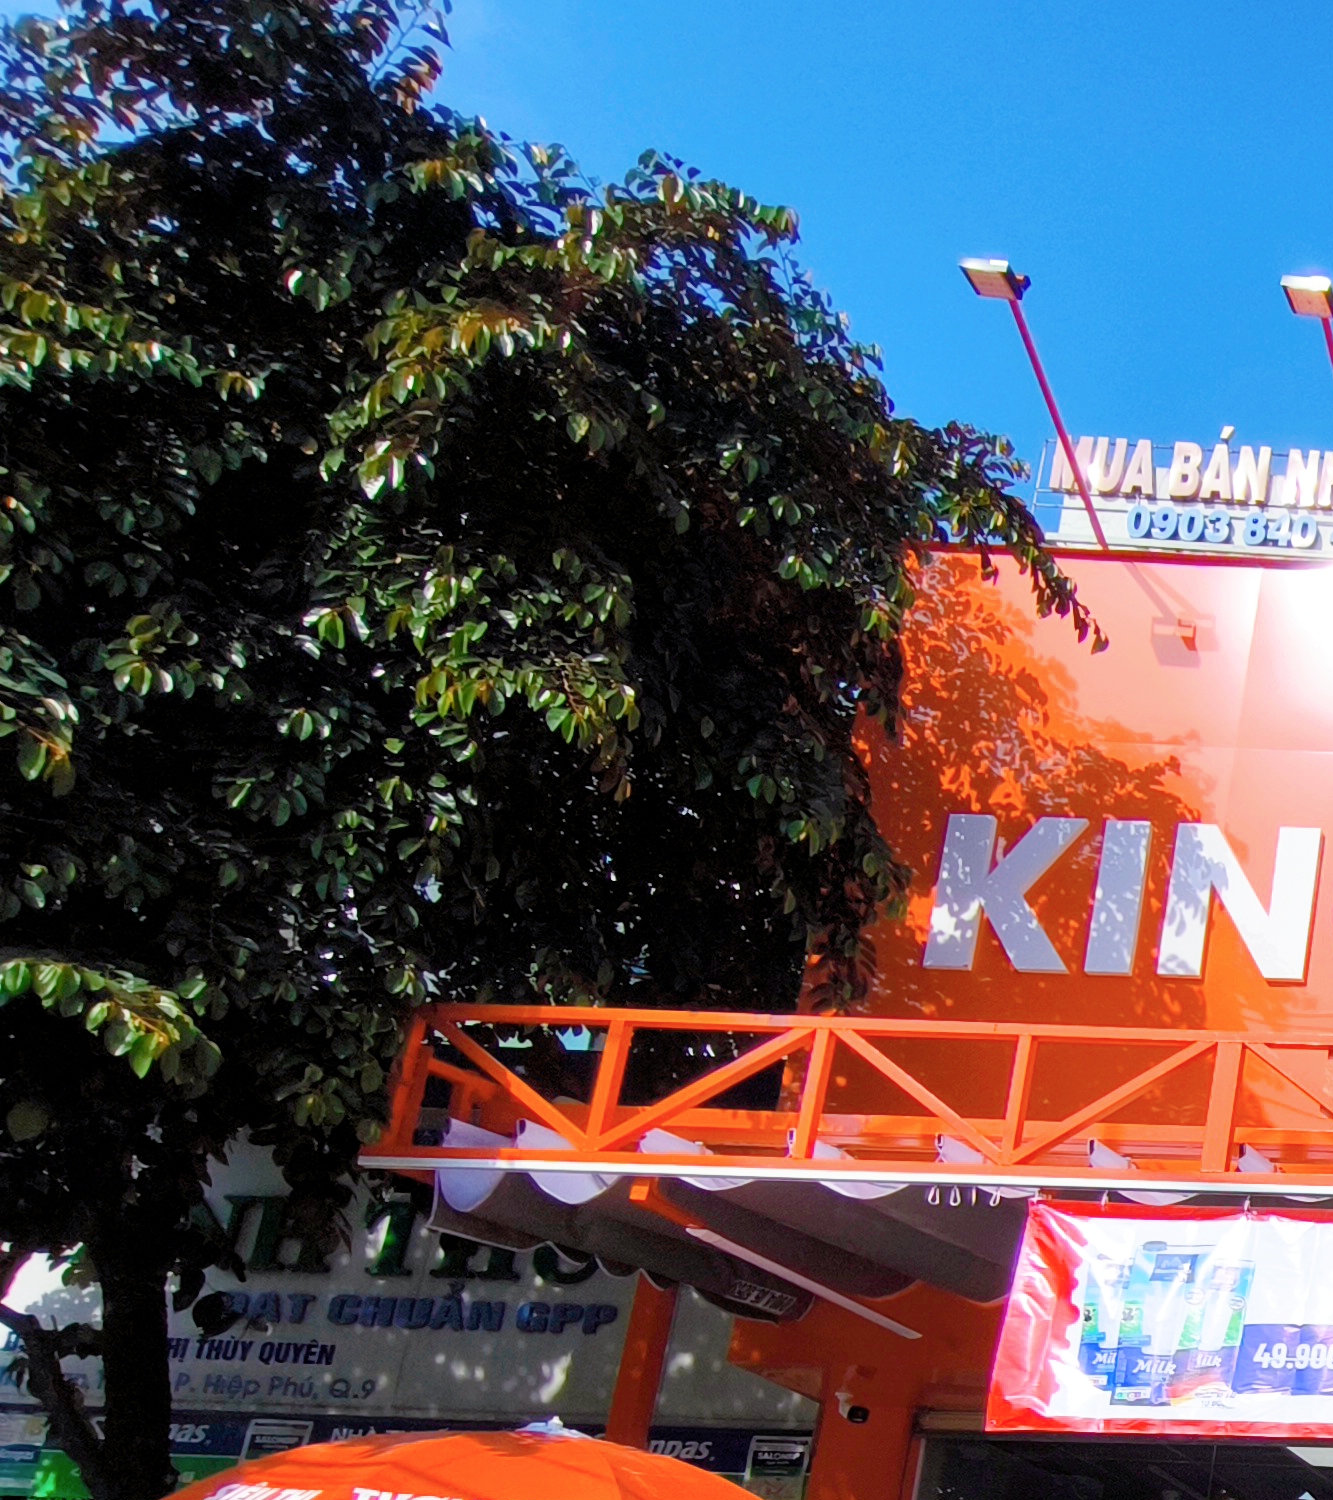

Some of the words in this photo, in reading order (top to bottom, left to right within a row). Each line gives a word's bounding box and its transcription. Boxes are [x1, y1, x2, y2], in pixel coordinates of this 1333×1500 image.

[1049, 434, 1154, 497] MUA
[1169, 426, 1271, 505] BÁN
[1126, 505, 1232, 543] 0903
[1243, 511, 1317, 549] 840
[515, 1302, 619, 1335] GPP
[259, 1338, 336, 1367] QUYÊN
